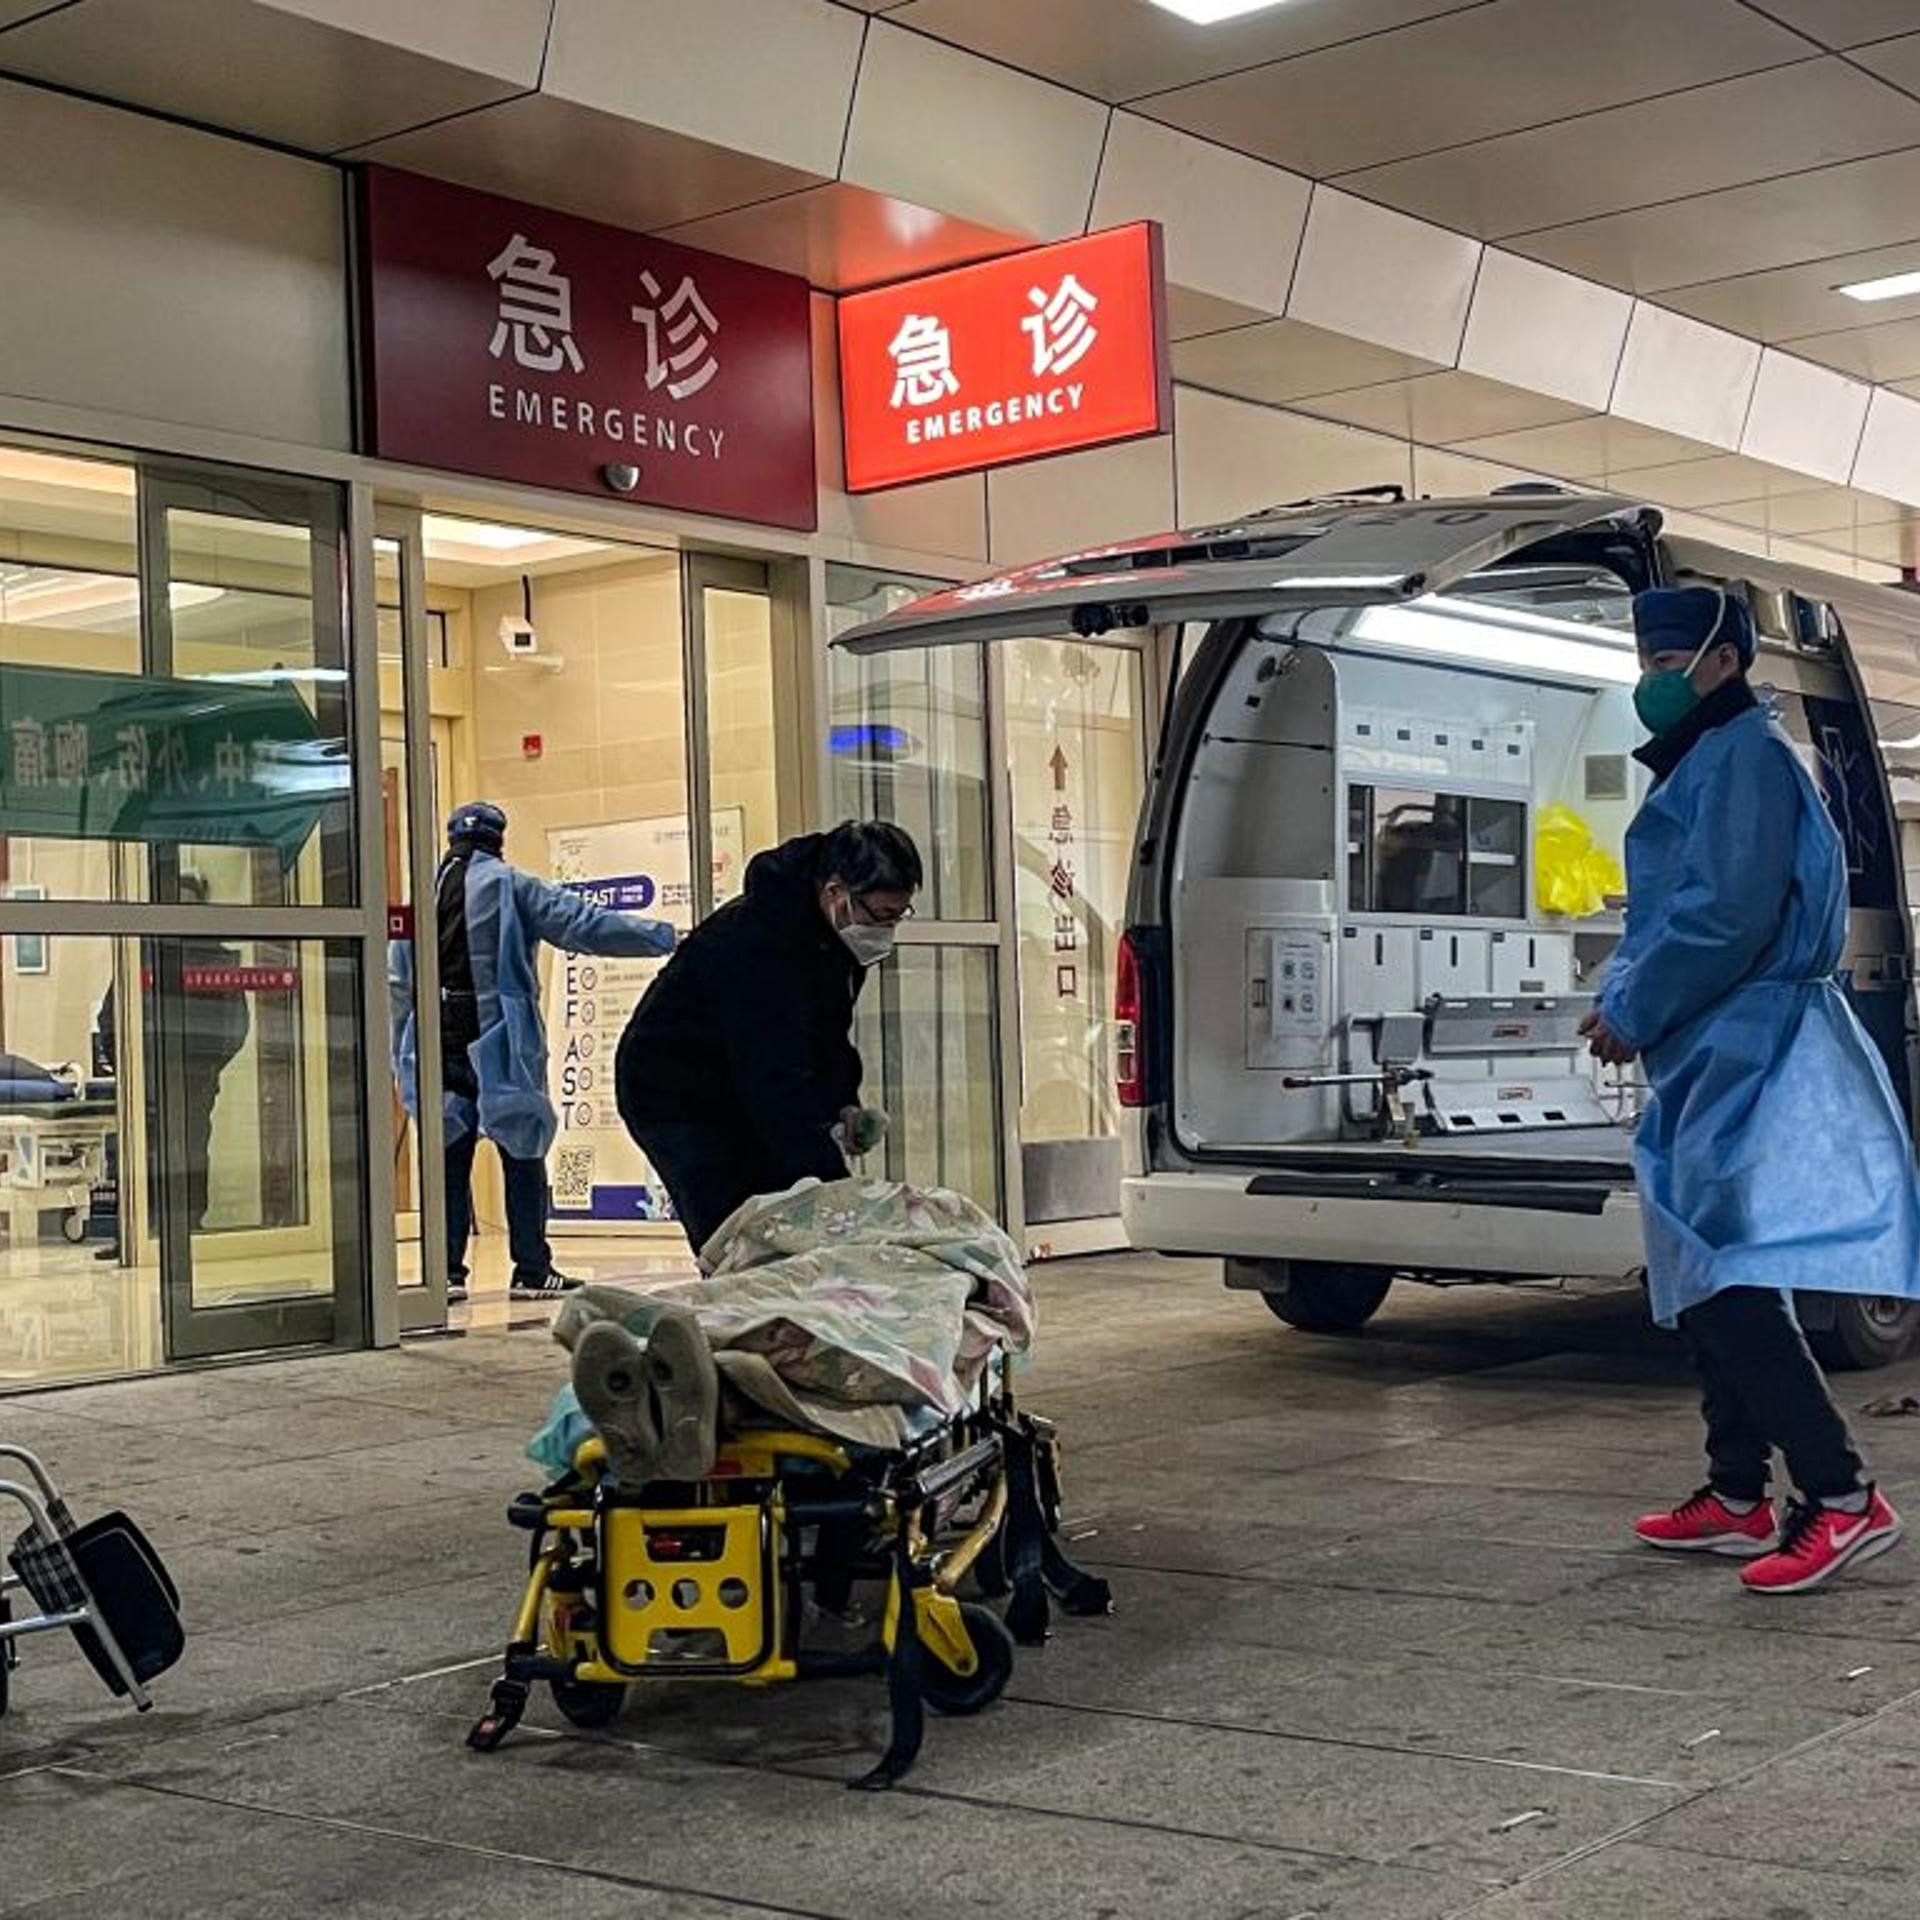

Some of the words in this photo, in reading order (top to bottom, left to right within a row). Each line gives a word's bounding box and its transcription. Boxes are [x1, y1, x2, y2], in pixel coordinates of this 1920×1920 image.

[486, 233, 721, 400] 急诊
[888, 273, 1099, 408] 急诊
[488, 383, 727, 461] EMERGENCY
[905, 383, 1086, 445] EMERGENCY
